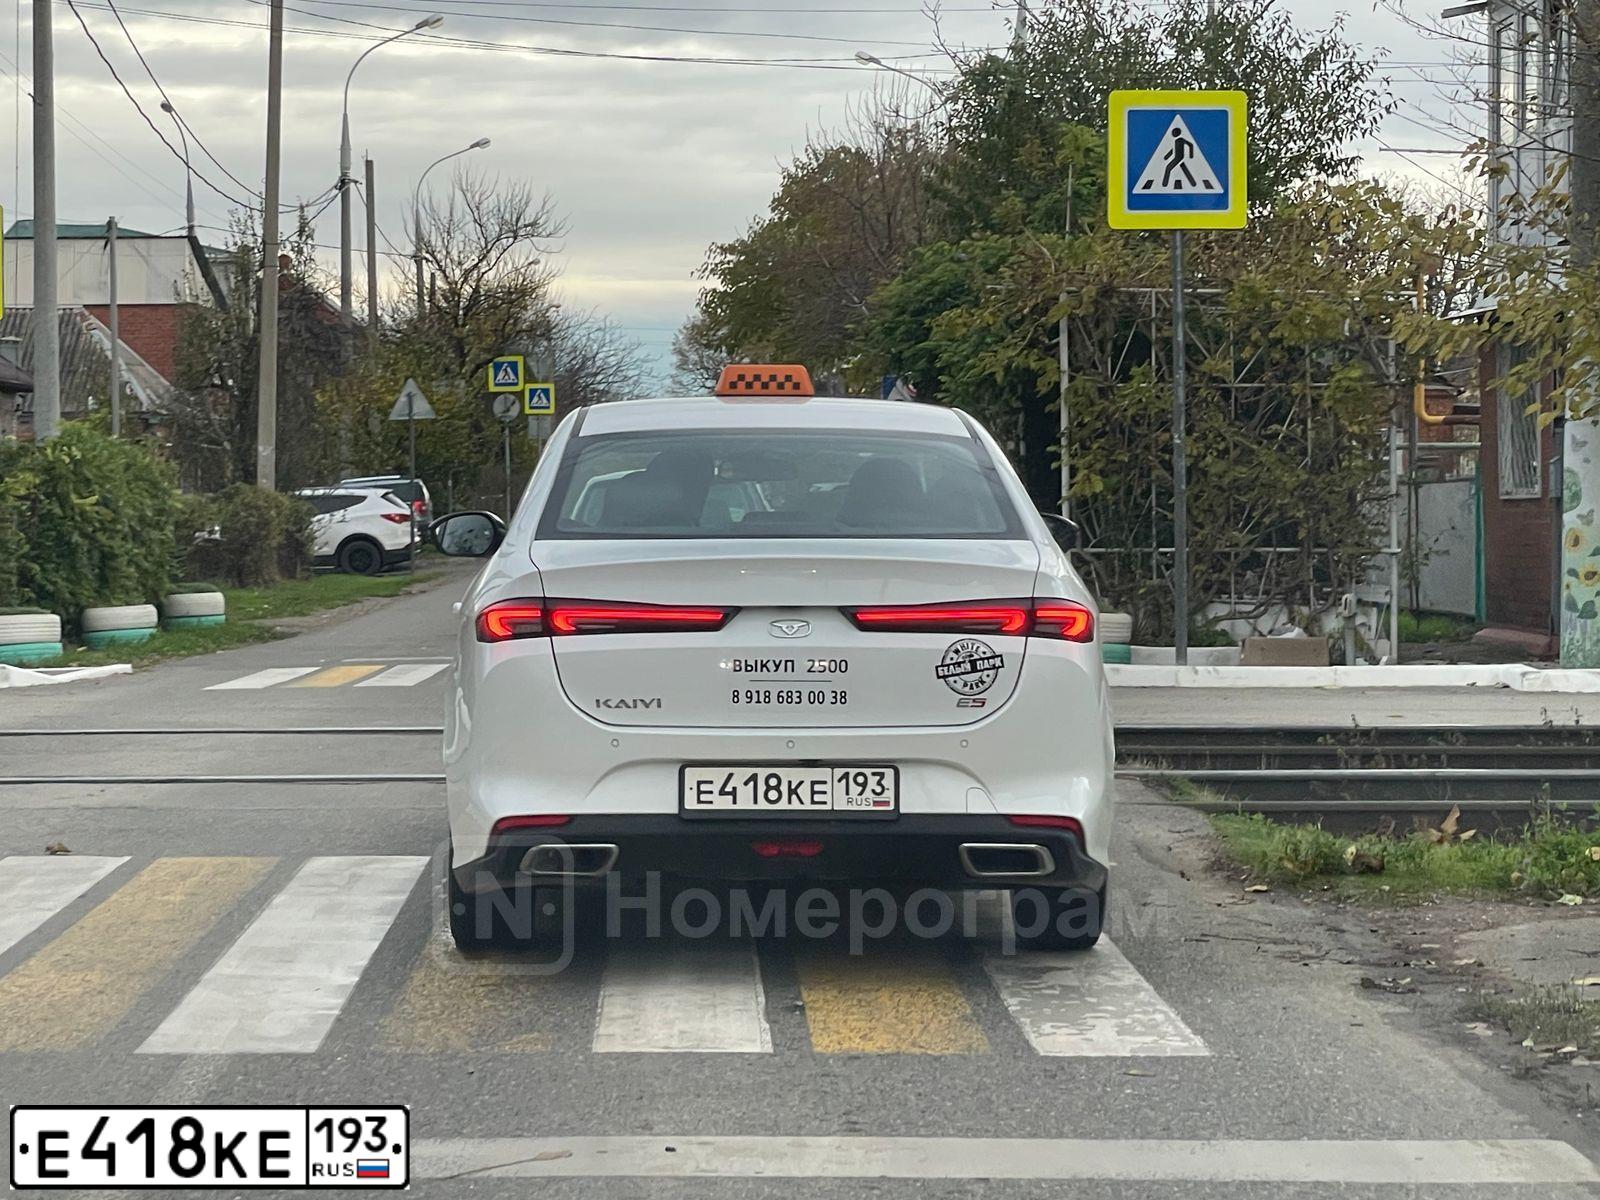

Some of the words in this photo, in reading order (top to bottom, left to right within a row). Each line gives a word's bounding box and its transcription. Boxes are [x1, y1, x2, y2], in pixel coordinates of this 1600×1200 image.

[952, 642, 981, 656] WHITE
[732, 659, 796, 673] ВЫКУП
[806, 659, 849, 674] 2500
[937, 659, 972, 677] БЕЛЫЙ
[976, 656, 1003, 671] ПАРК
[962, 676, 987, 691] PARK
[595, 697, 662, 709] KAIYI
[731, 689, 740, 704] 8
[745, 689, 772, 704] 918
[776, 689, 803, 704] 683
[807, 689, 825, 704] 00
[830, 689, 848, 704] 38
[696, 772, 828, 806] Е418КЕ
[836, 771, 886, 797] 193
[846, 797, 871, 807] RUS
